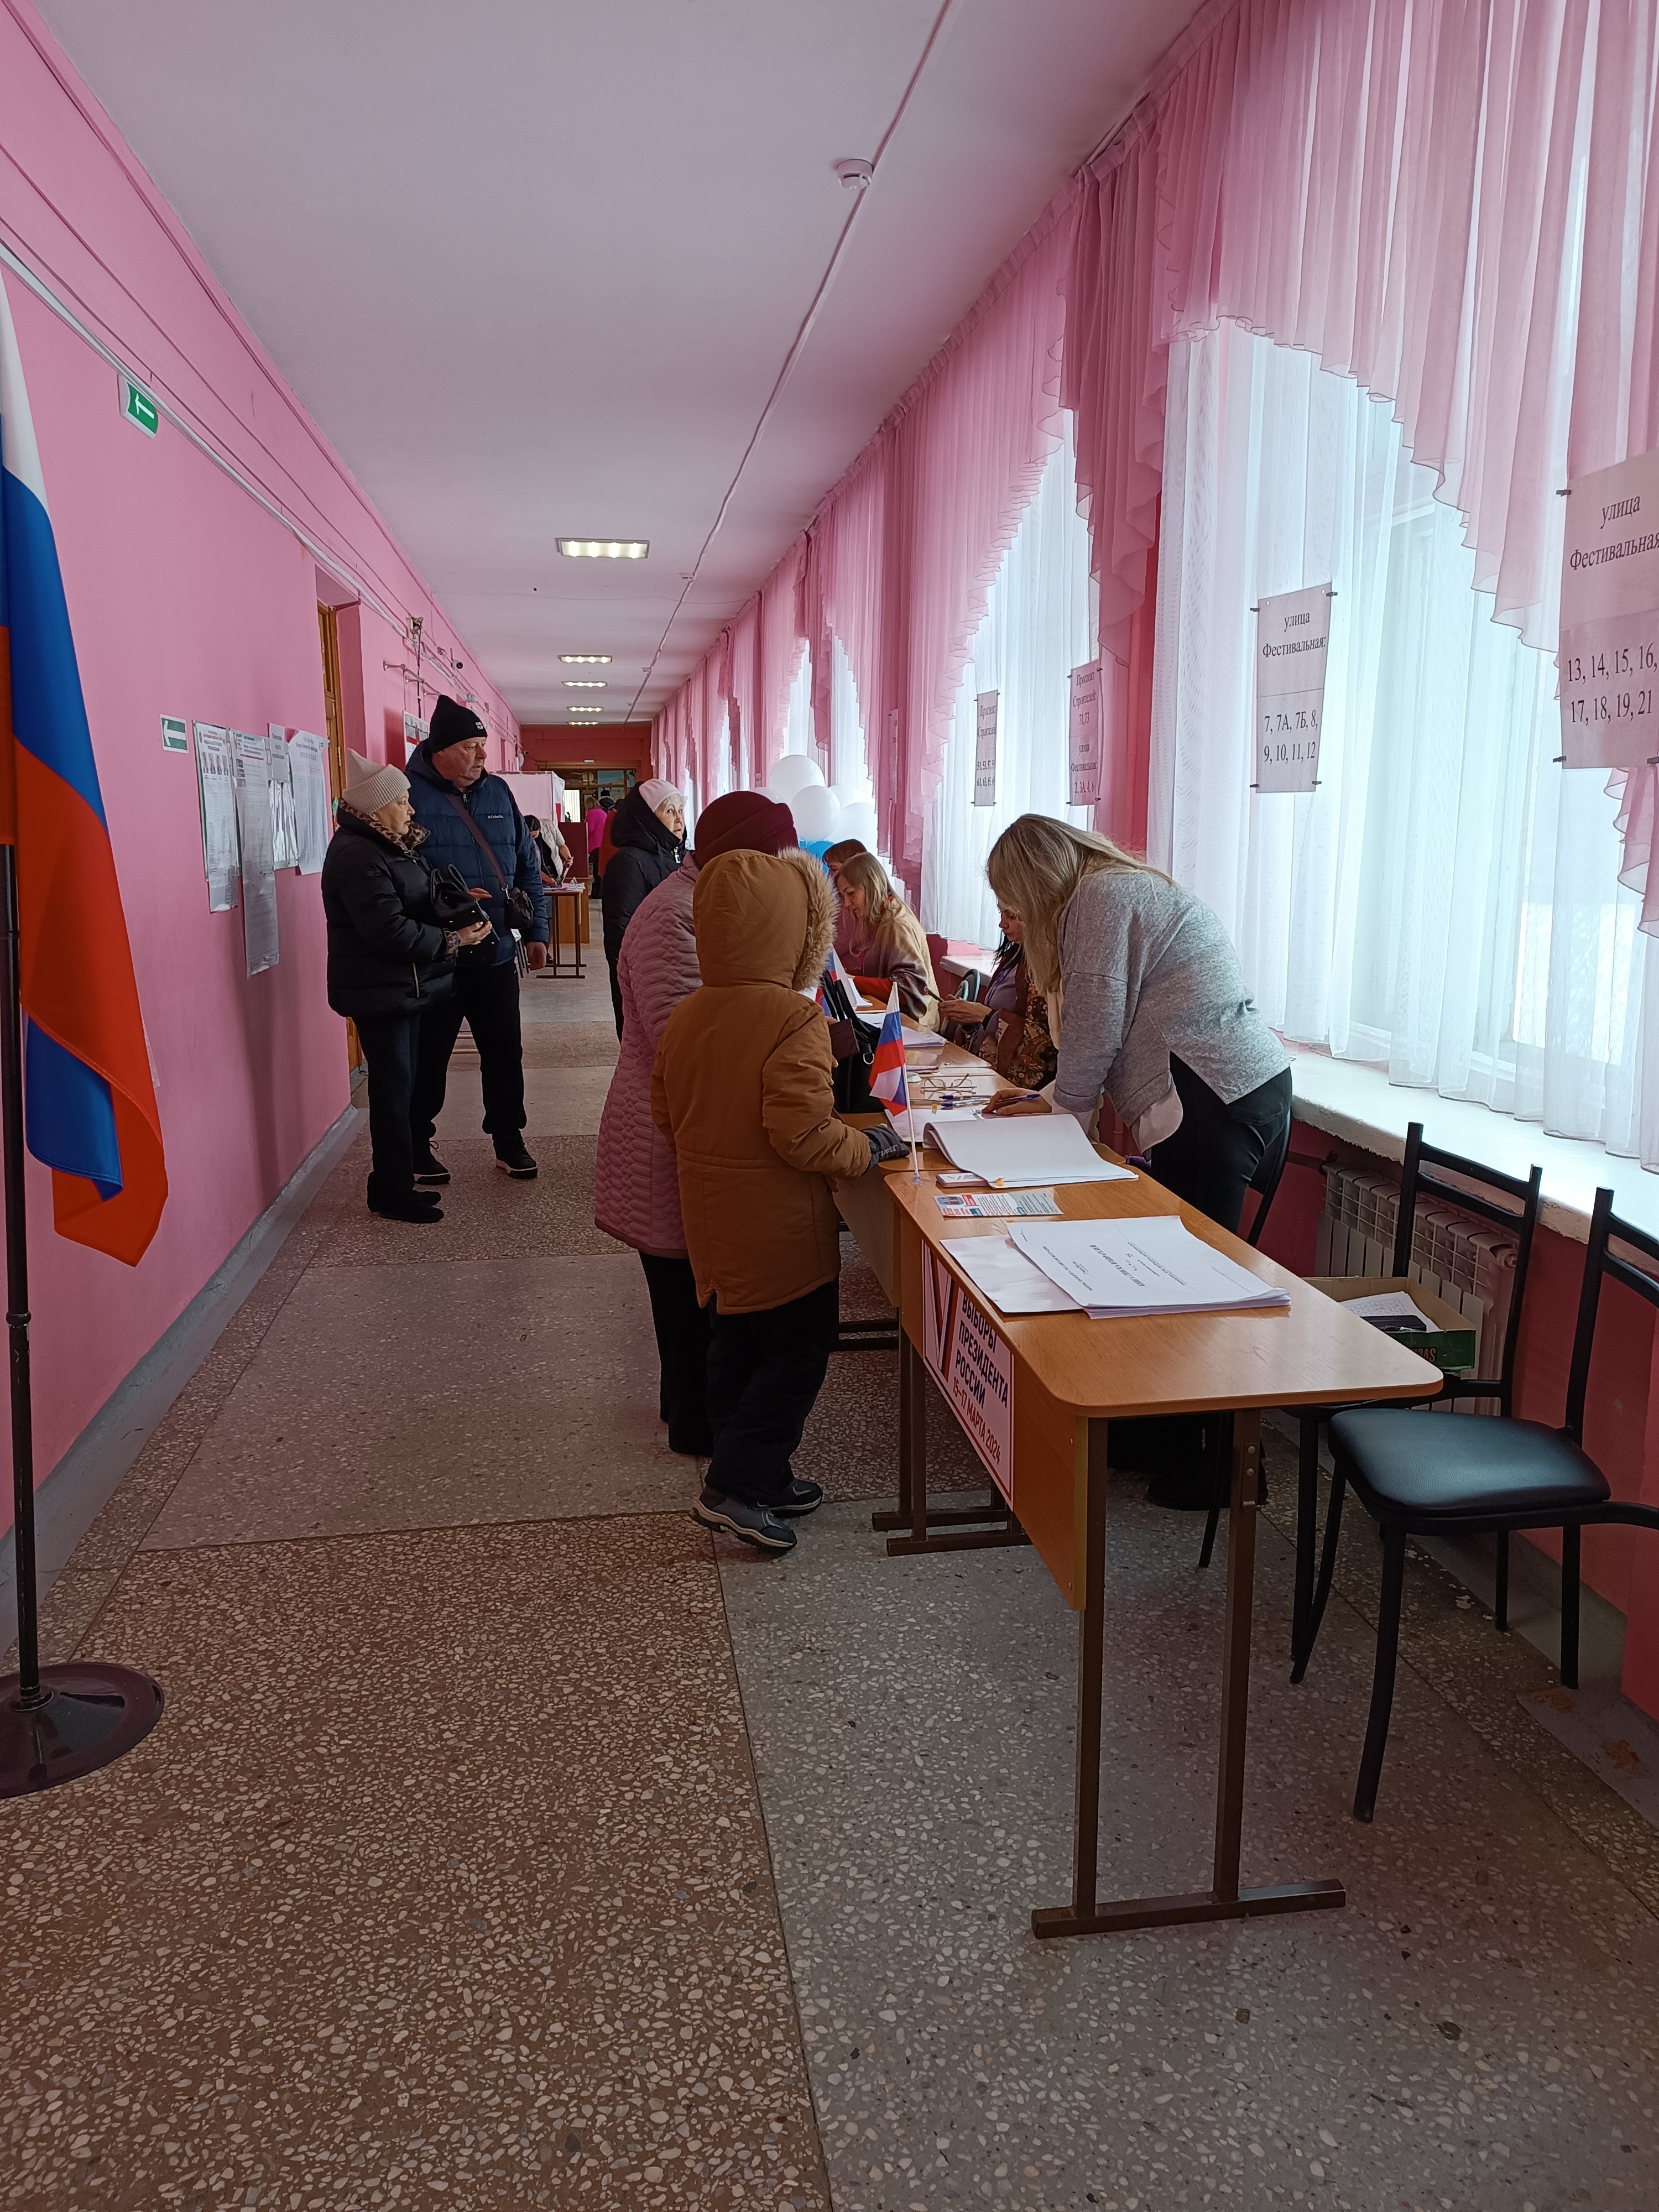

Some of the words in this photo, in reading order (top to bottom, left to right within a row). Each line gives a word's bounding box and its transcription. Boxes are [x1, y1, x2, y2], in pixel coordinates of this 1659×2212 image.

[1600, 496, 1640, 529] улица
[1570, 532, 1659, 571] Фестивальная
[1284, 612, 1310, 632] улица
[1263, 637, 1326, 658] Фестивальная:
[1567, 659, 1585, 684] 13,
[1592, 653, 1609, 680] 14,
[1615, 649, 1633, 676] 15,
[1639, 643, 1657, 672] 16,
[1265, 716, 1272, 734] 7,
[1276, 714, 1291, 733] 7А,
[1296, 712, 1308, 731] 7Б,
[1311, 709, 1317, 729] 8,
[1571, 700, 1589, 726] 17,
[1594, 696, 1611, 723] 18,
[1616, 692, 1633, 721] 19,
[1637, 689, 1652, 714] 21
[1264, 745, 1272, 764] 9,
[1276, 744, 1288, 763] 10,
[1292, 743, 1303, 763] 11,
[1307, 741, 1316, 759] 12
[963, 1295, 996, 1354] ВЫБОРЫ
[956, 1348, 986, 1409] РОССИИ
[958, 1320, 1008, 1408] ПРЕЗИДЕНТА
[967, 1400, 986, 1442] МАРТА
[986, 1428, 1000, 1465] 2024
